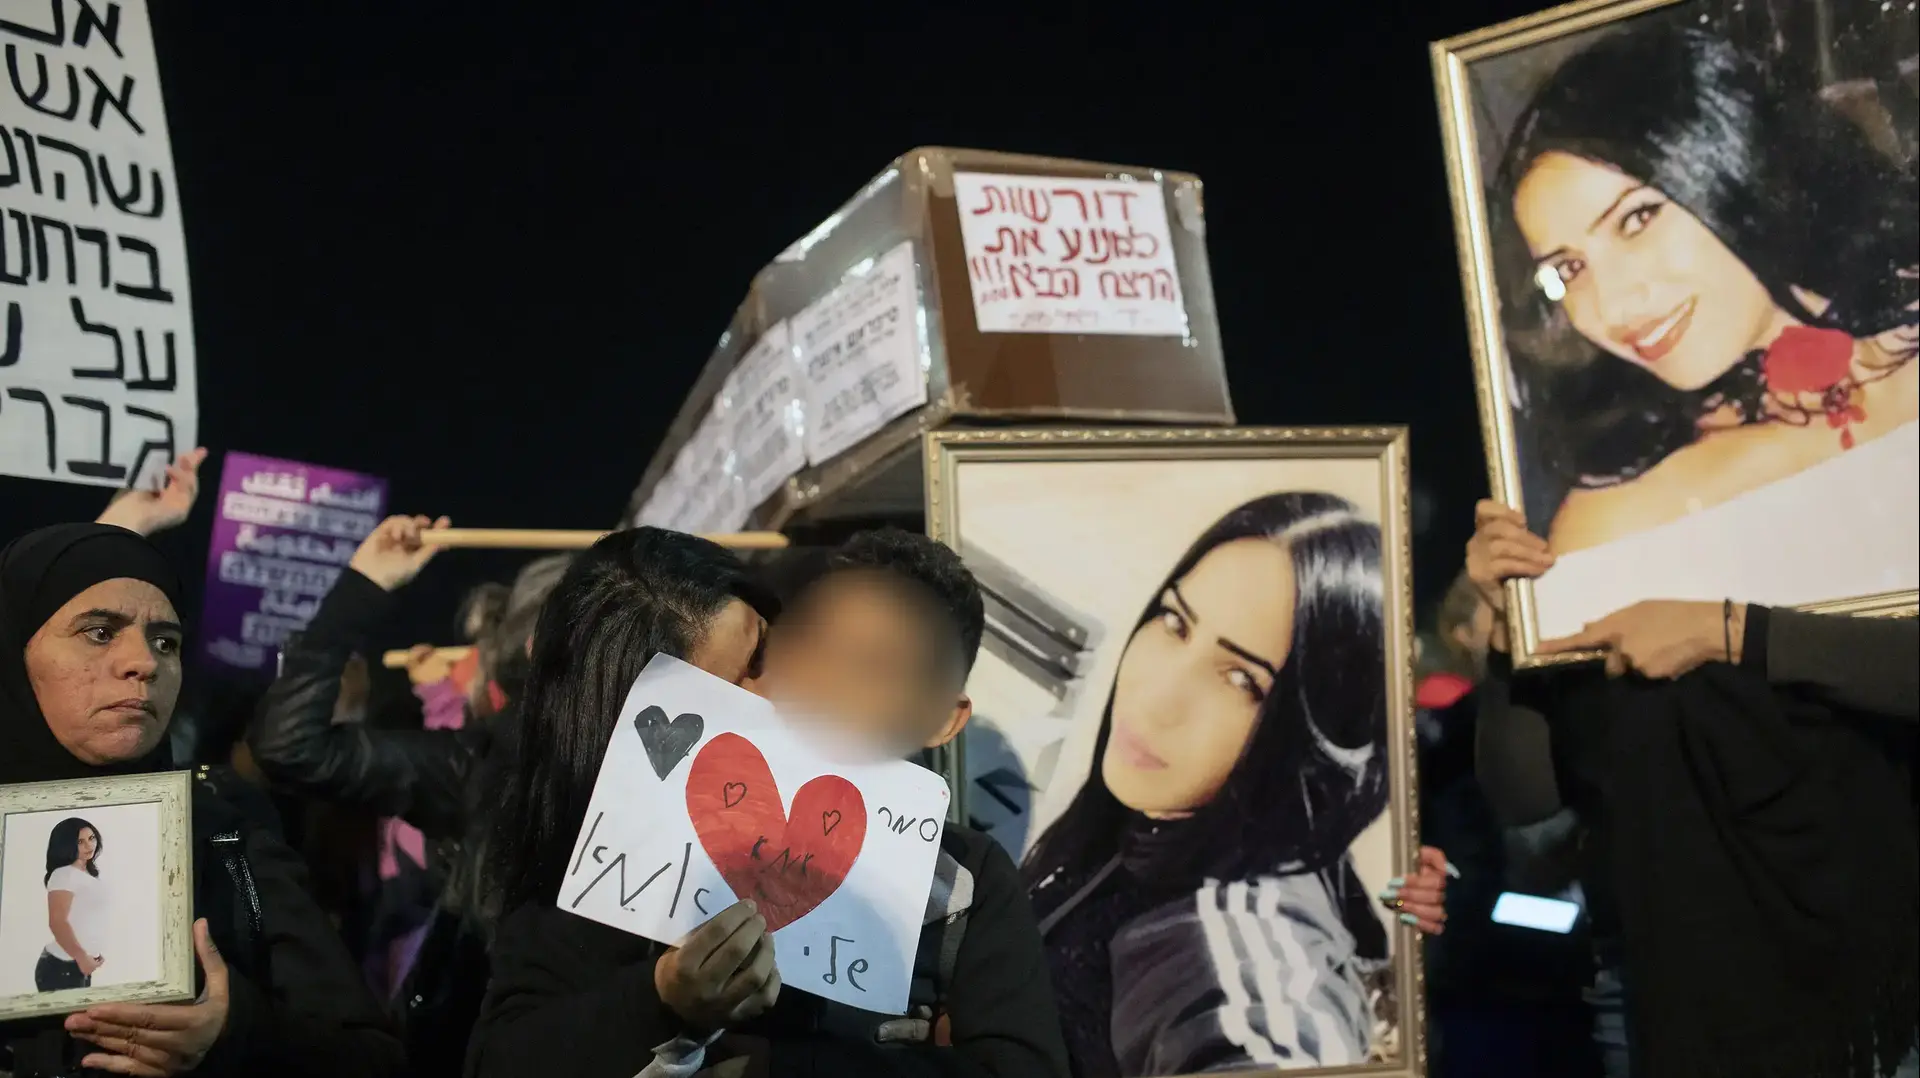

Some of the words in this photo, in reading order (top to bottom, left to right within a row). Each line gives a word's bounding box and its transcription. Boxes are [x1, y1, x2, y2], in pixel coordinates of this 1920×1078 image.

[973, 185, 1137, 223] דורשות
[983, 226, 1046, 257] את
[1057, 225, 1159, 264] למנוע
[1099, 268, 1176, 303] הרצח
[70, 296, 176, 391] על
[878, 806, 939, 842] סמר
[803, 935, 869, 992] שלי
